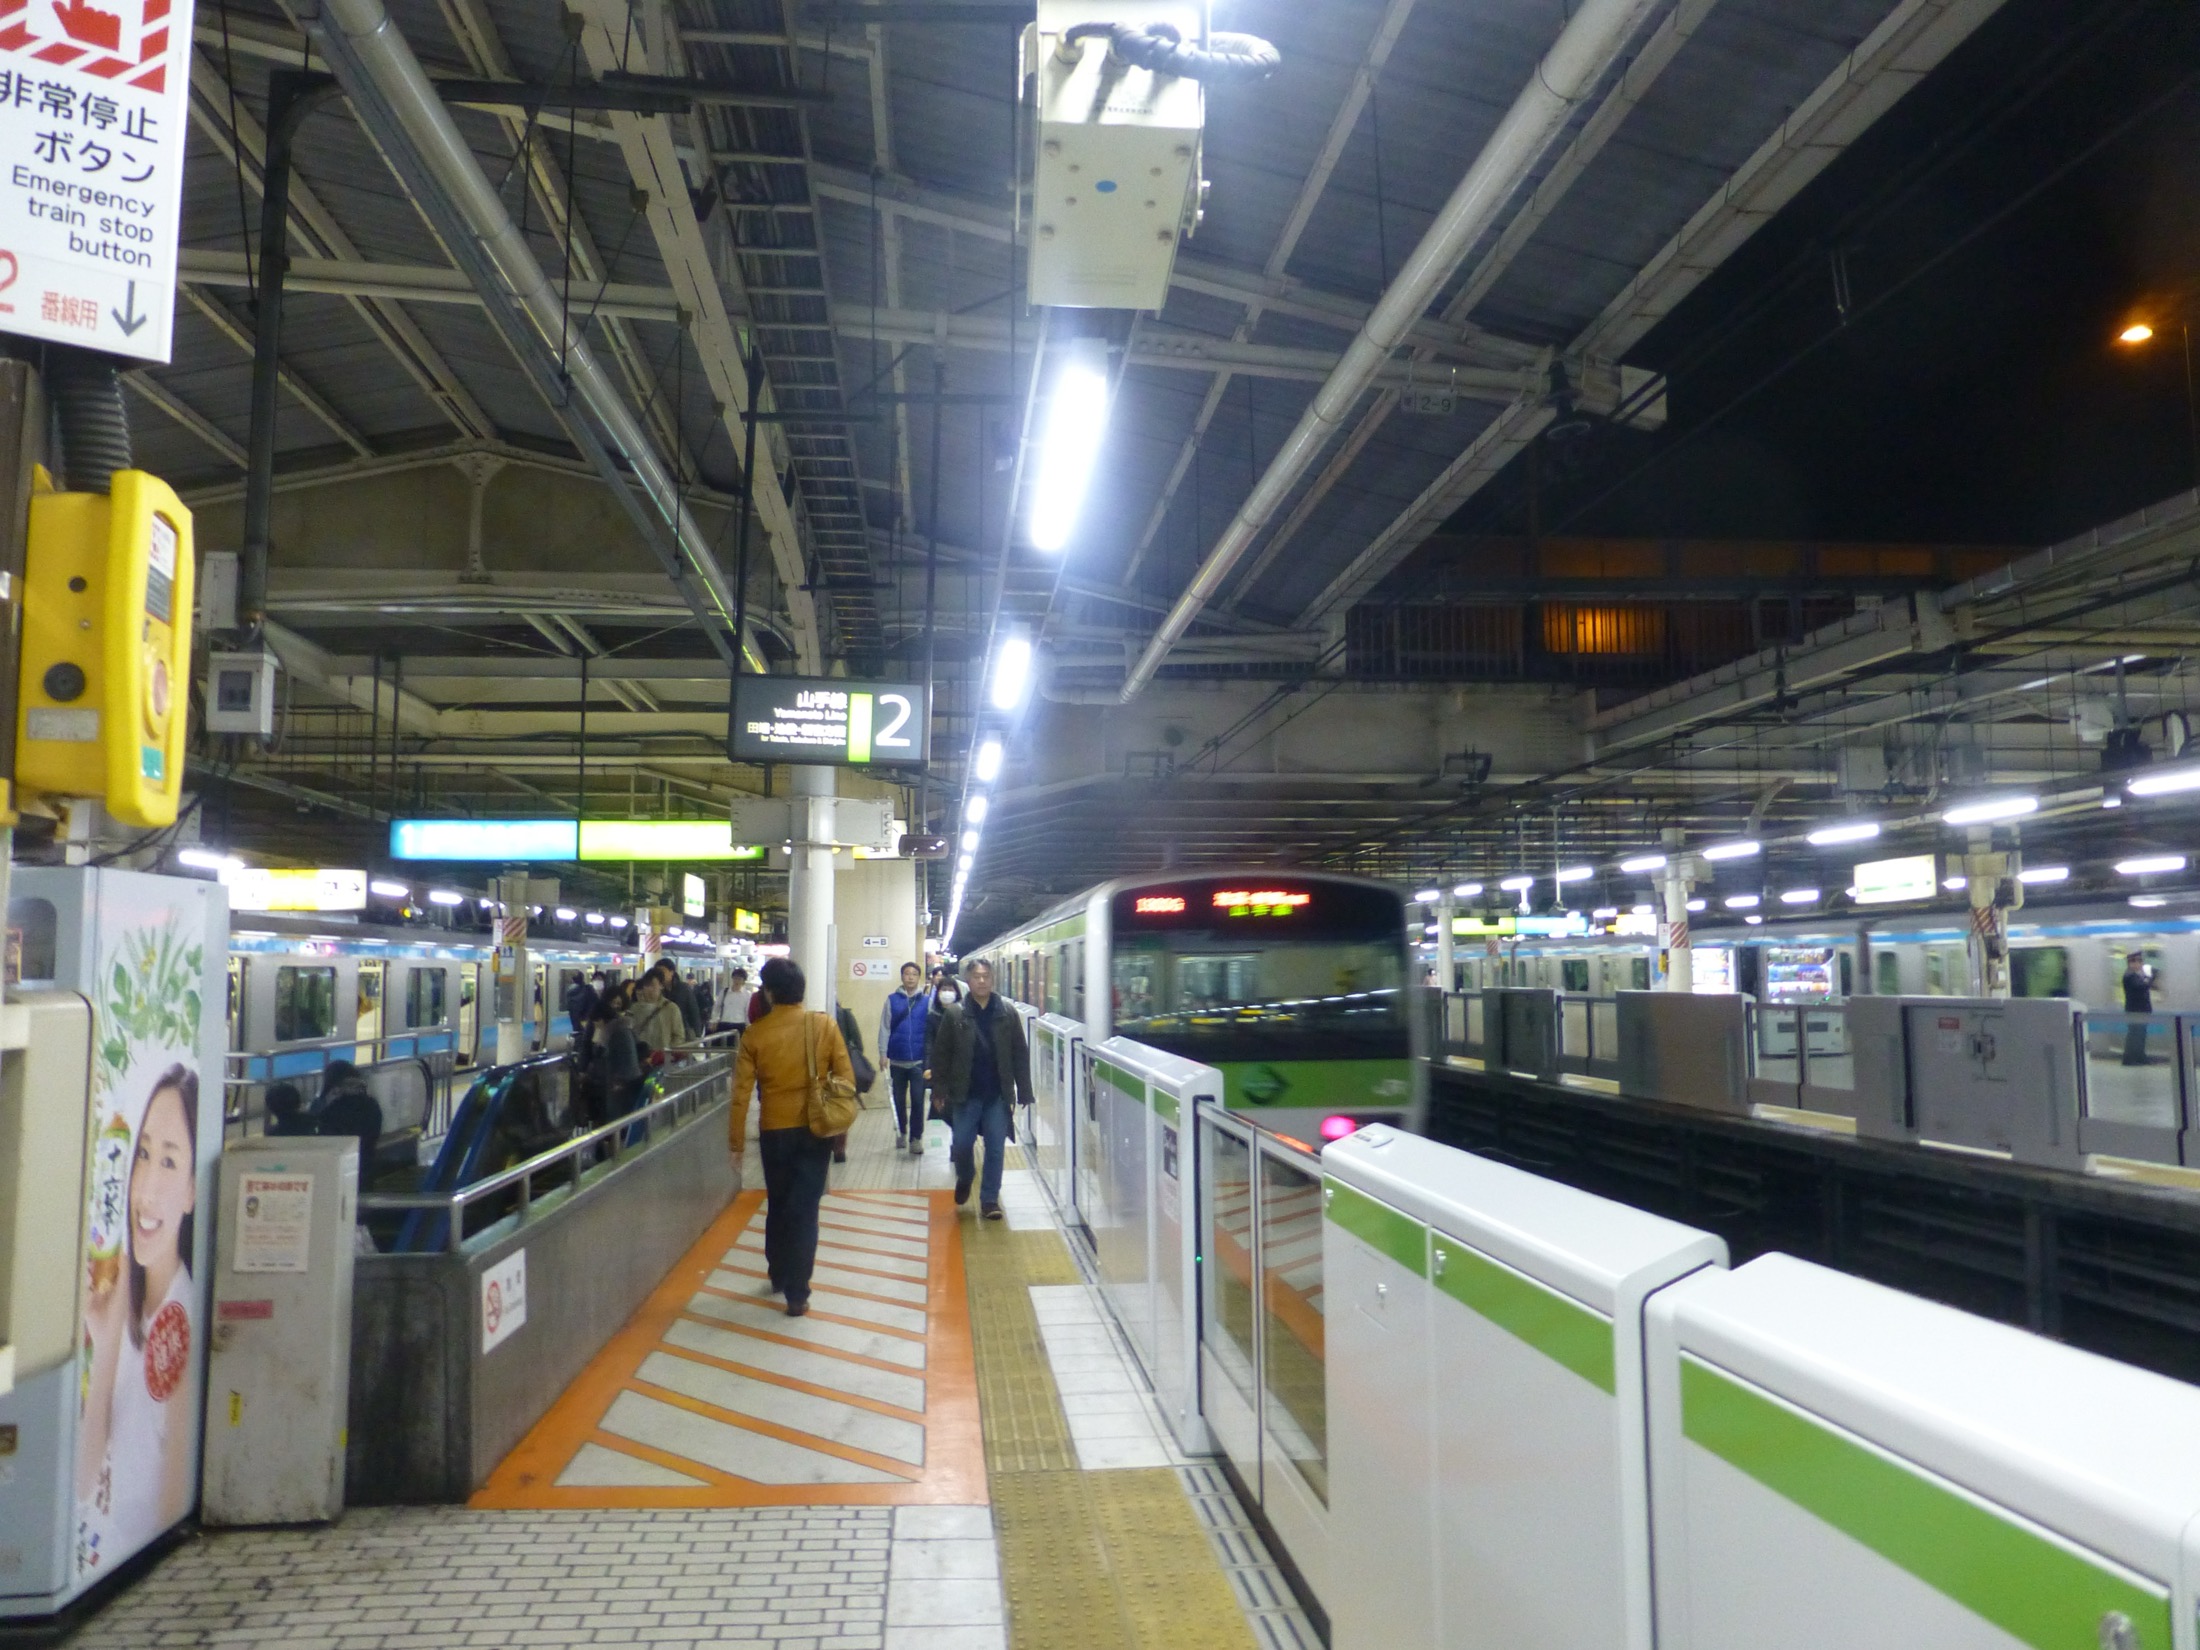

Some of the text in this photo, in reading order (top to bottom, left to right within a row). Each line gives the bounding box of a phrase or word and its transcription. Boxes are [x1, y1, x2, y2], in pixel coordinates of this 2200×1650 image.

[0, 70, 158, 144] 非常停止
[34, 131, 155, 182] ボタン
[12, 165, 155, 218] Emergency
[28, 197, 154, 243] train stop
[69, 230, 152, 268] button
[875, 693, 911, 747] 2
